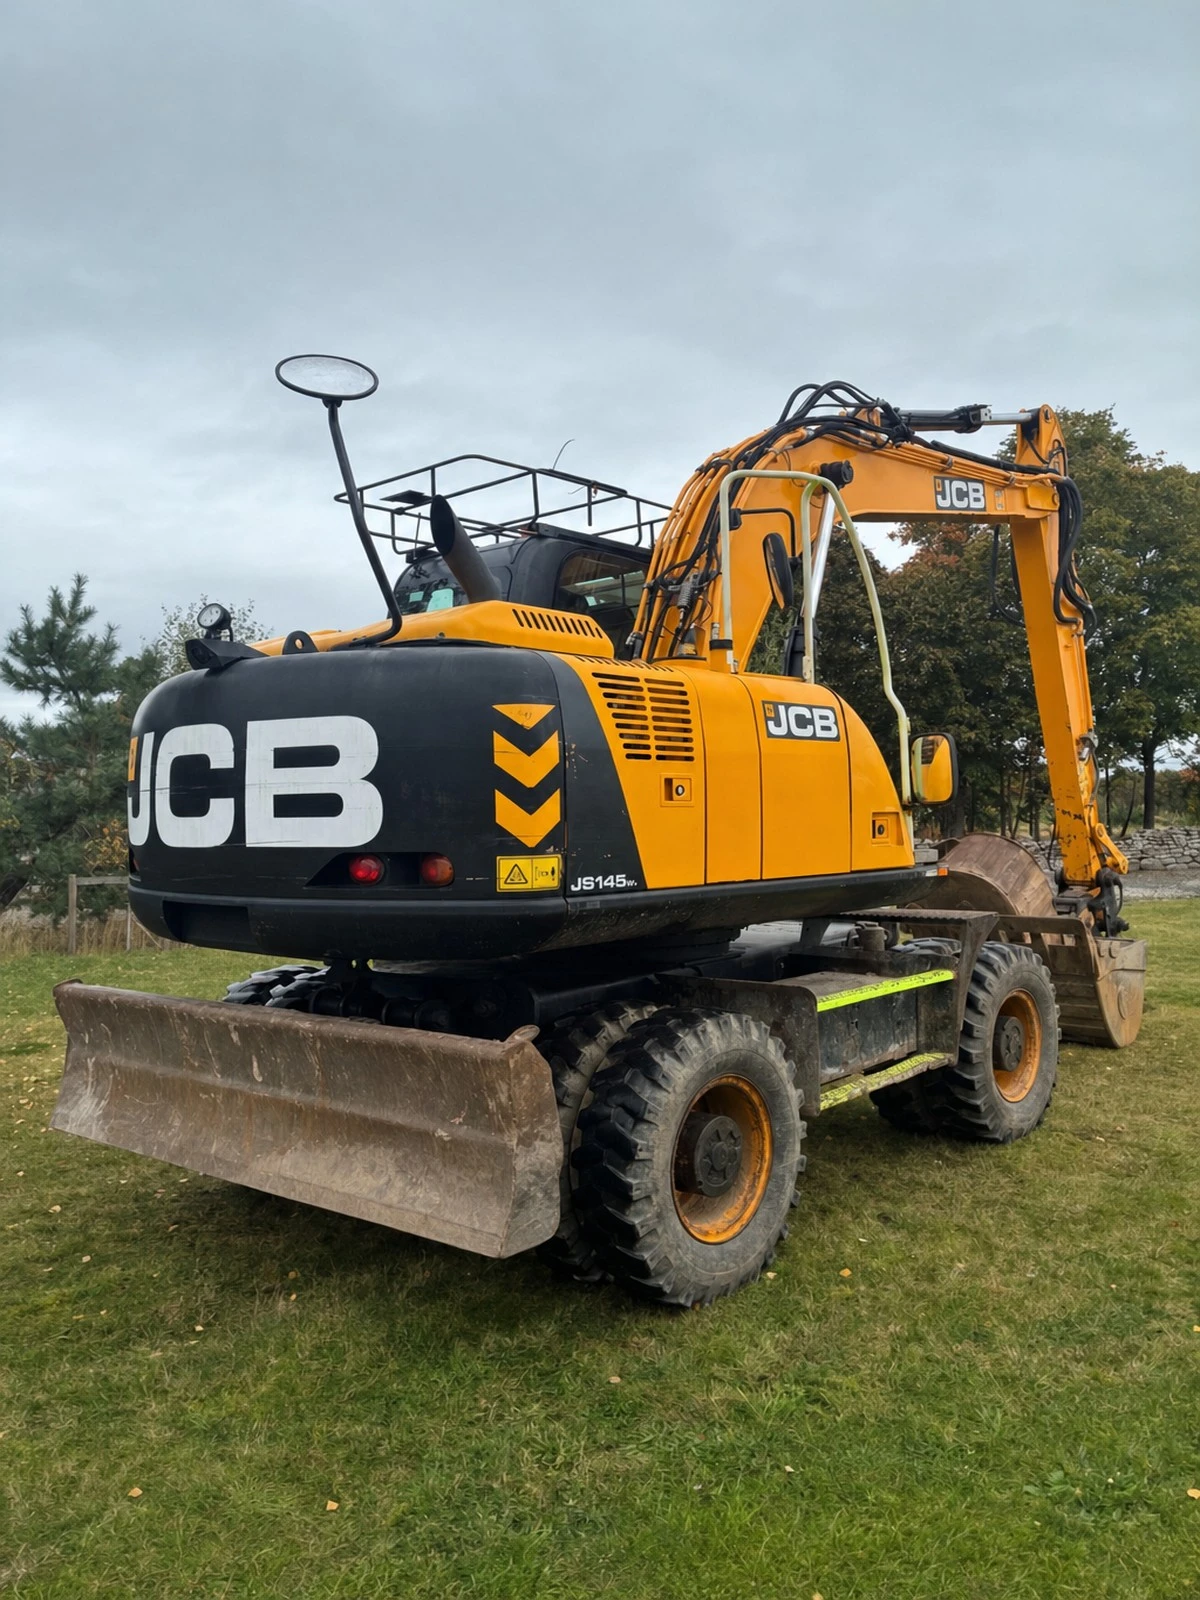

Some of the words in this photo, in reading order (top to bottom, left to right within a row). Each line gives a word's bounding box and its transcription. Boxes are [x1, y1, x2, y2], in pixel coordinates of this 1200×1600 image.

[936, 479, 985, 509] JCB
[766, 704, 839, 738] JCB
[127, 715, 384, 847] JCB
